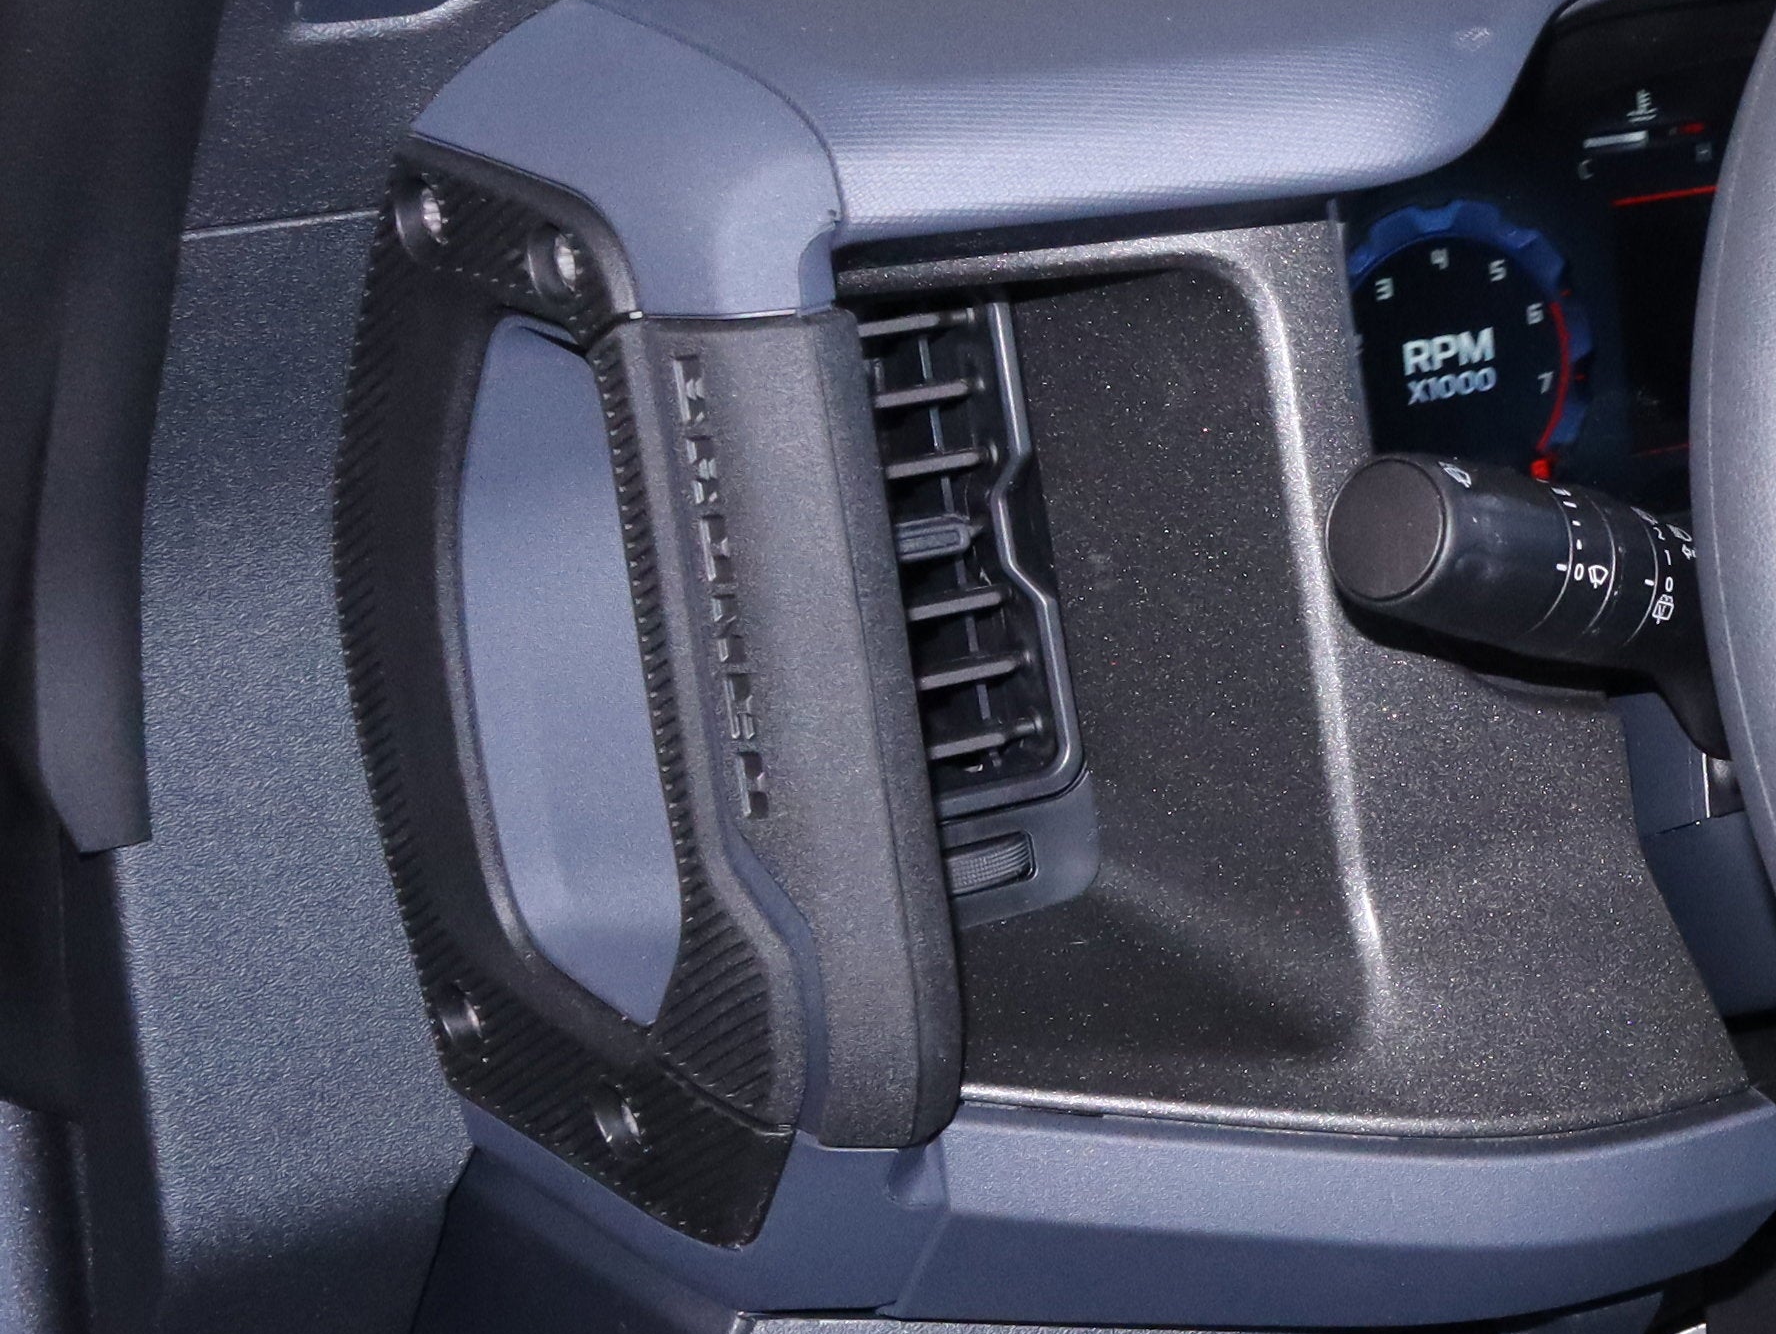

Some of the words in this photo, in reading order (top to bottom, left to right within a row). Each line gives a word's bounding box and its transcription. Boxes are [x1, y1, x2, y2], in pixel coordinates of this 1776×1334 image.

[1489, 259, 1507, 282] 5
[1375, 277, 1395, 301] 3
[1526, 302, 1544, 325] 6
[1402, 327, 1496, 376] RPM
[1406, 367, 1497, 405] X1000
[1537, 371, 1554, 394] 7
